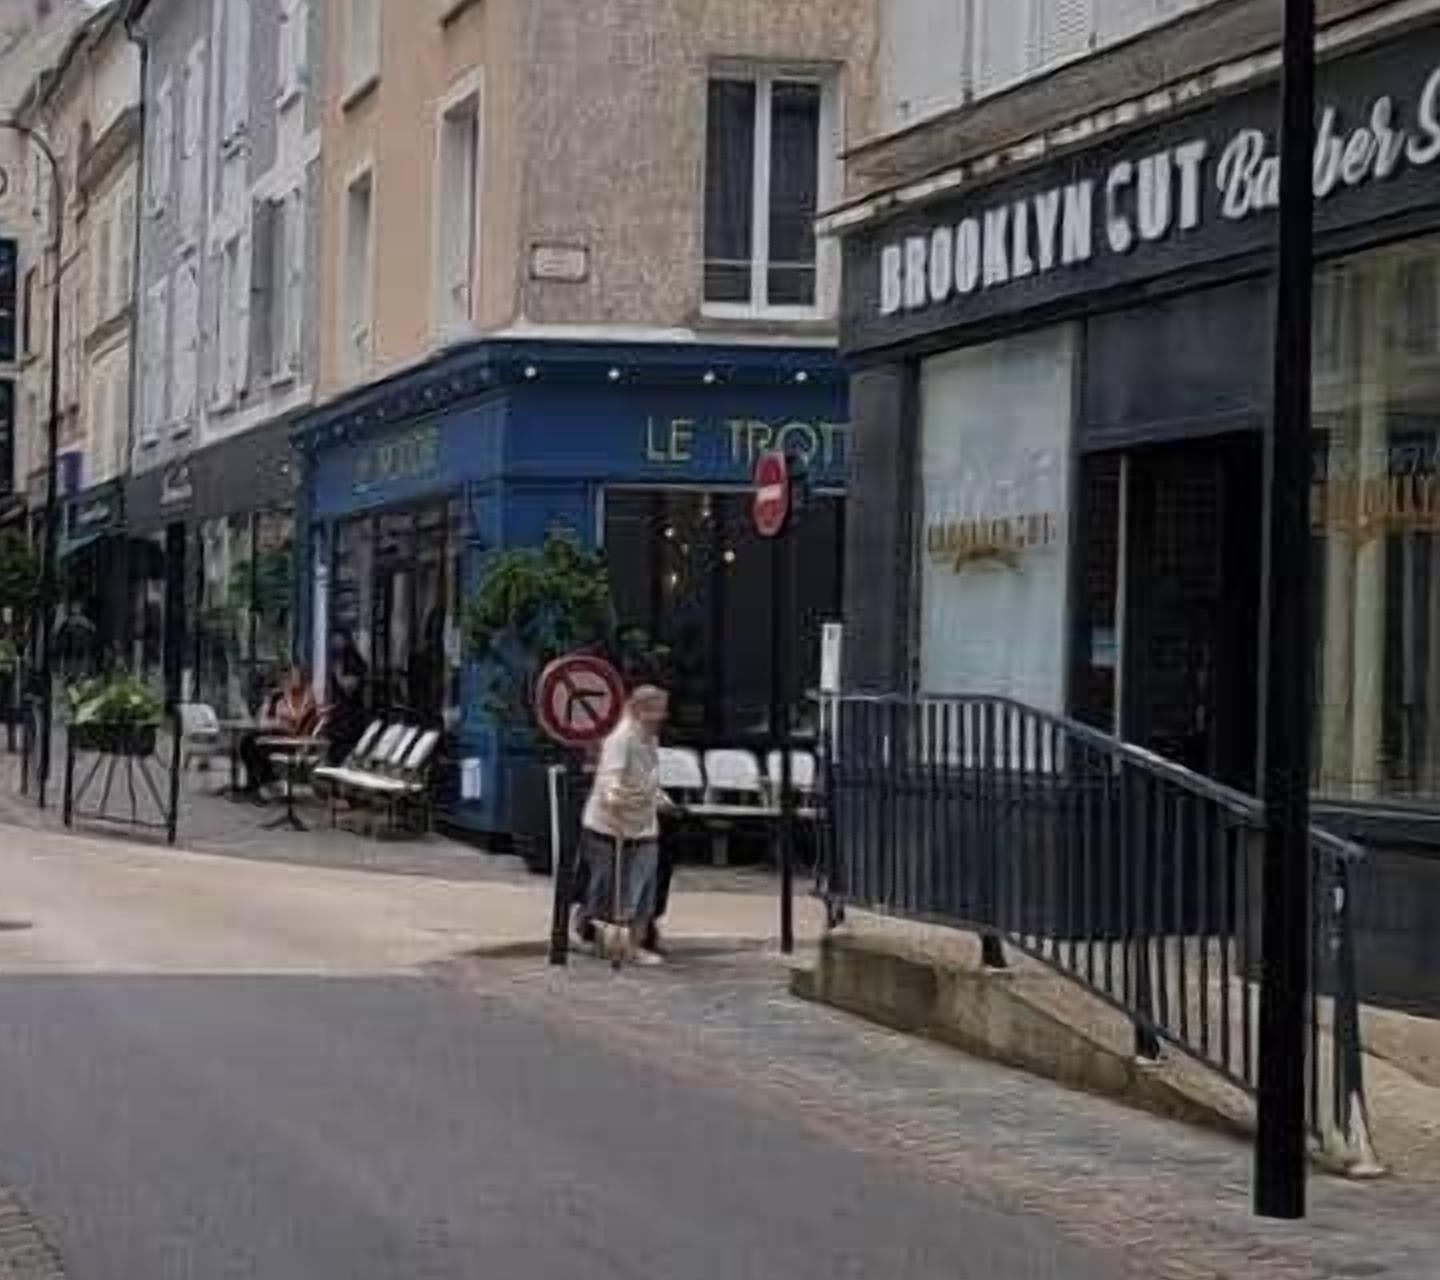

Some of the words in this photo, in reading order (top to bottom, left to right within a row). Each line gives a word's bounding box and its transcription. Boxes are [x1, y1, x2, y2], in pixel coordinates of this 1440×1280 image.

[880, 179, 1095, 315] BROOKLYN
[1105, 139, 1208, 253] CUT
[1216, 96, 1408, 220] Baber
[646, 417, 694, 461] LE
